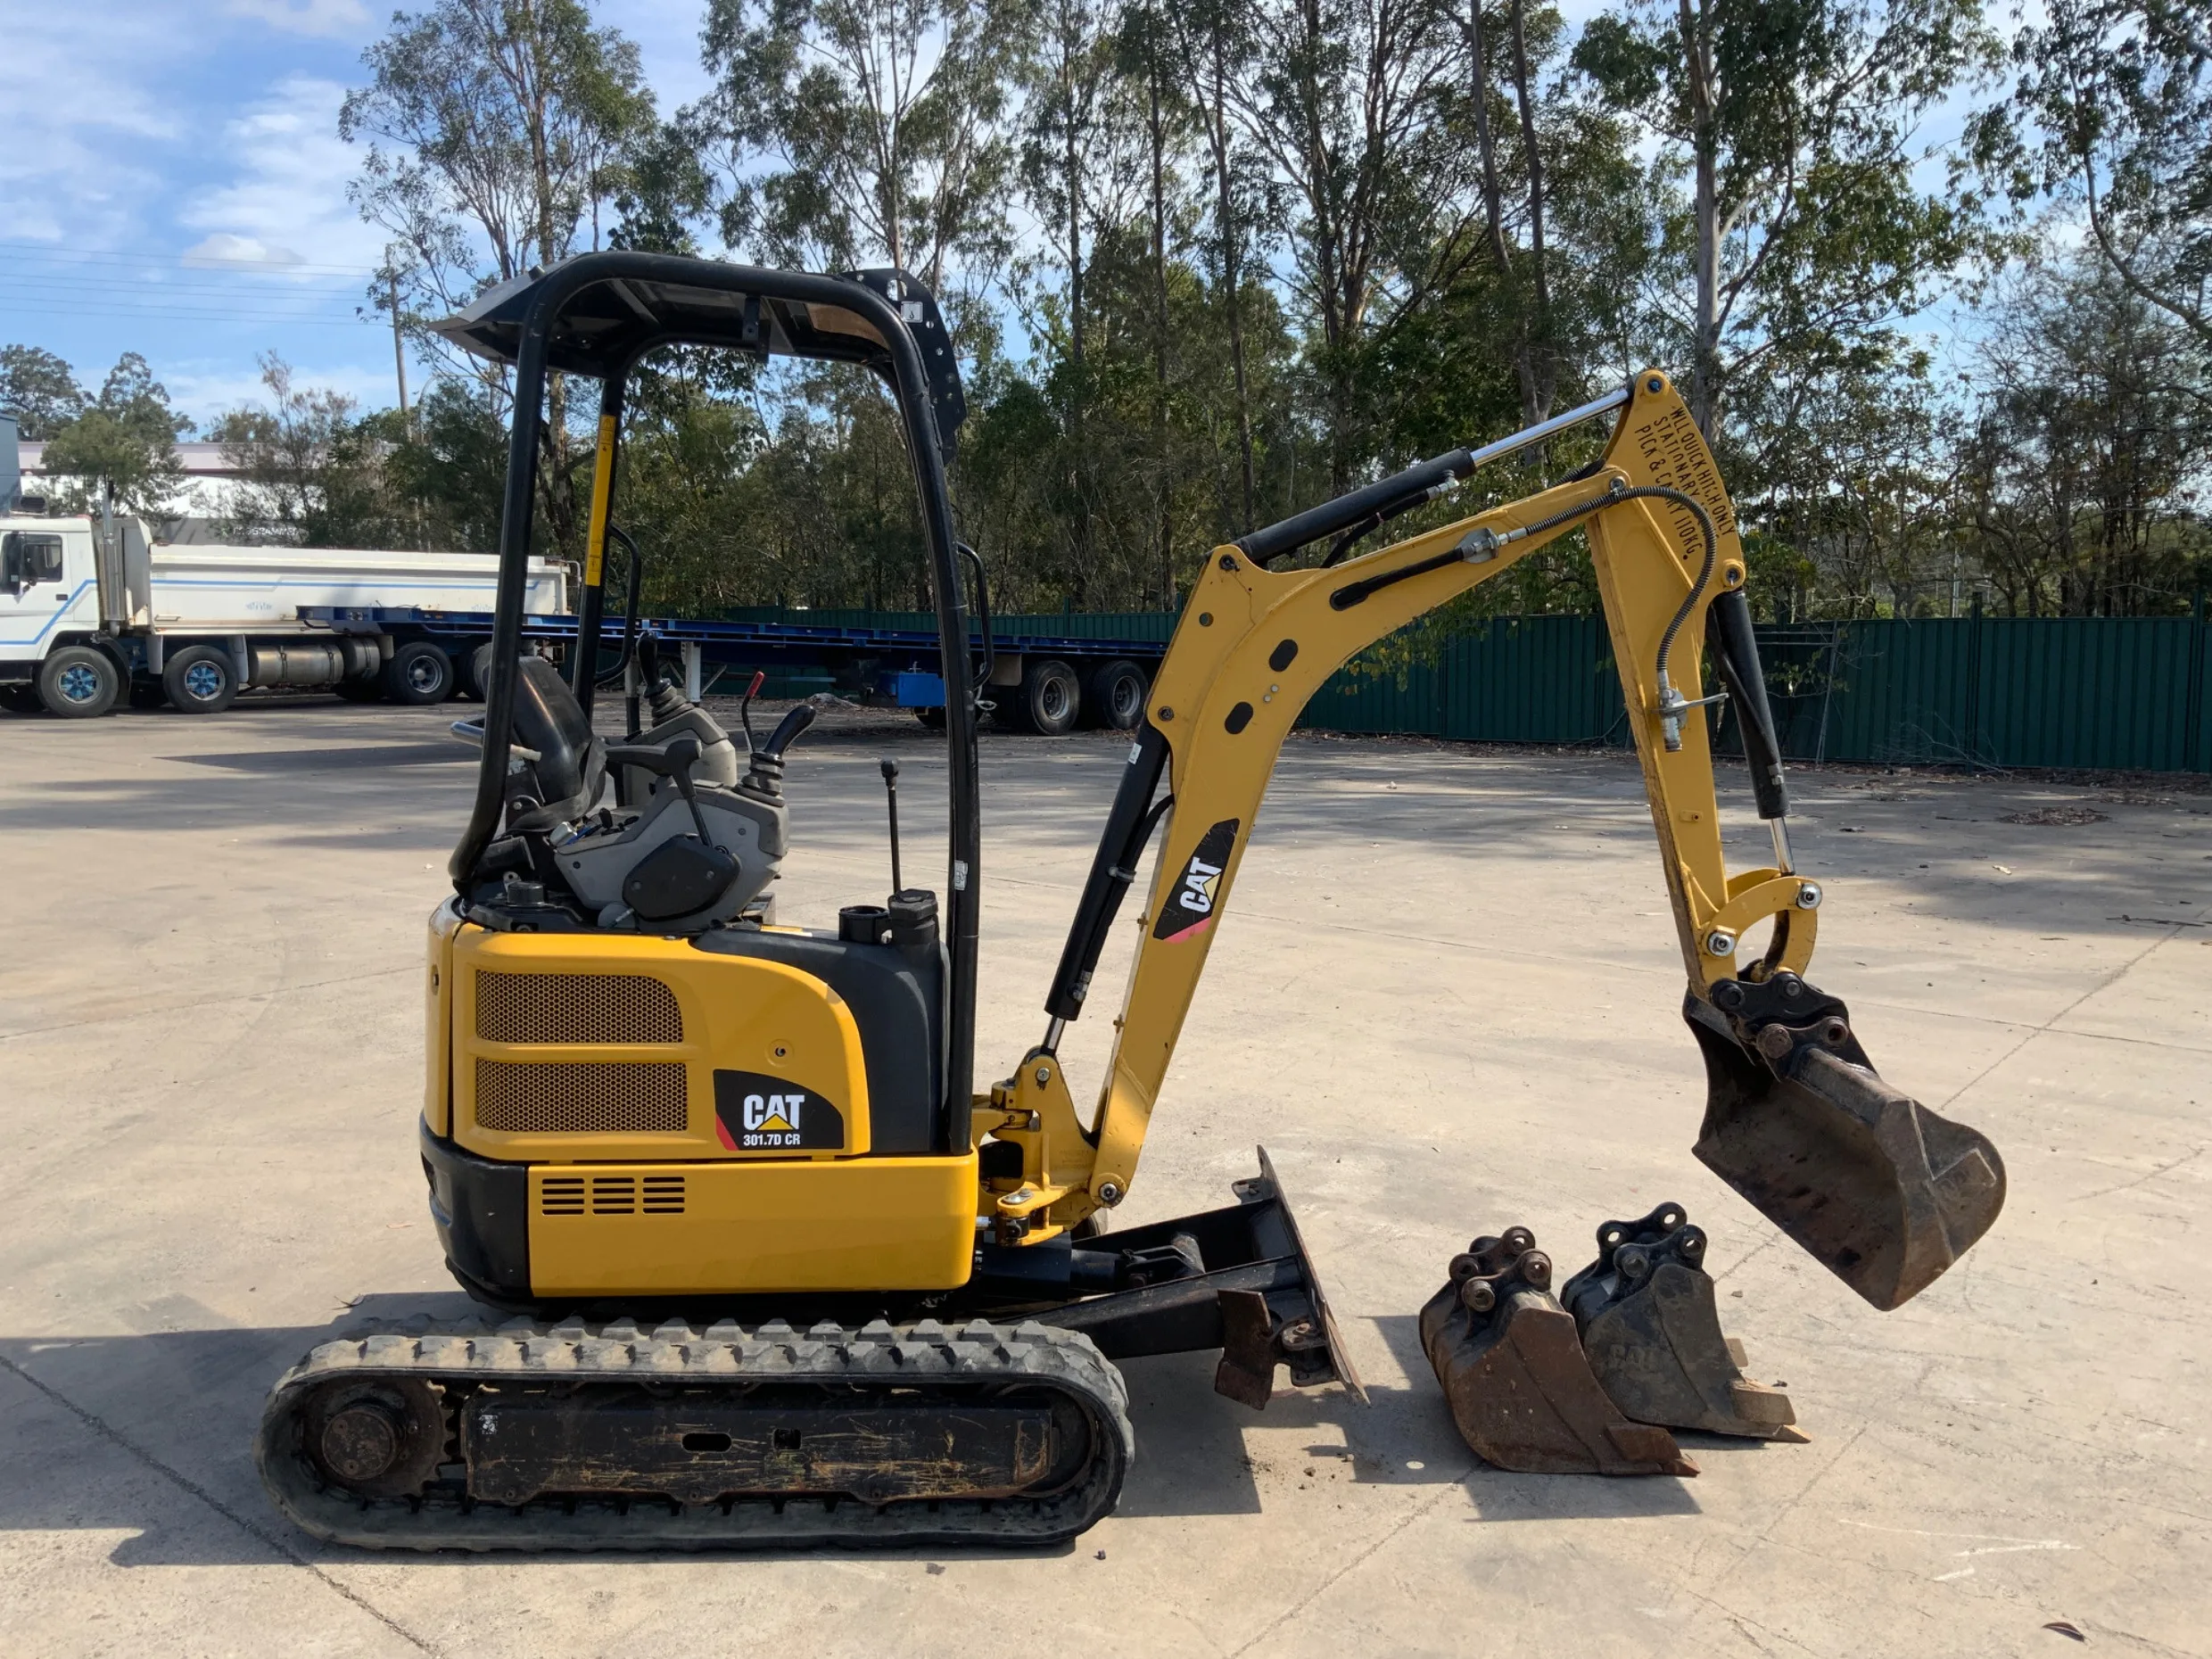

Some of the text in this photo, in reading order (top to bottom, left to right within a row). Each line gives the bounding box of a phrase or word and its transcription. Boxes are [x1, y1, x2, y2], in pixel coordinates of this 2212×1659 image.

[1634, 424, 1659, 458] PICK
[1648, 458, 1665, 472] &
[1653, 416, 1700, 500] STATIONARY
[1669, 406, 1689, 433] WLL
[1680, 432, 1706, 471] QUICK
[1712, 505, 1735, 535] ONLY
[1179, 856, 1222, 913] CAT
[743, 1094, 805, 1131] CAT
[743, 1134, 801, 1146] 301.7D CR
